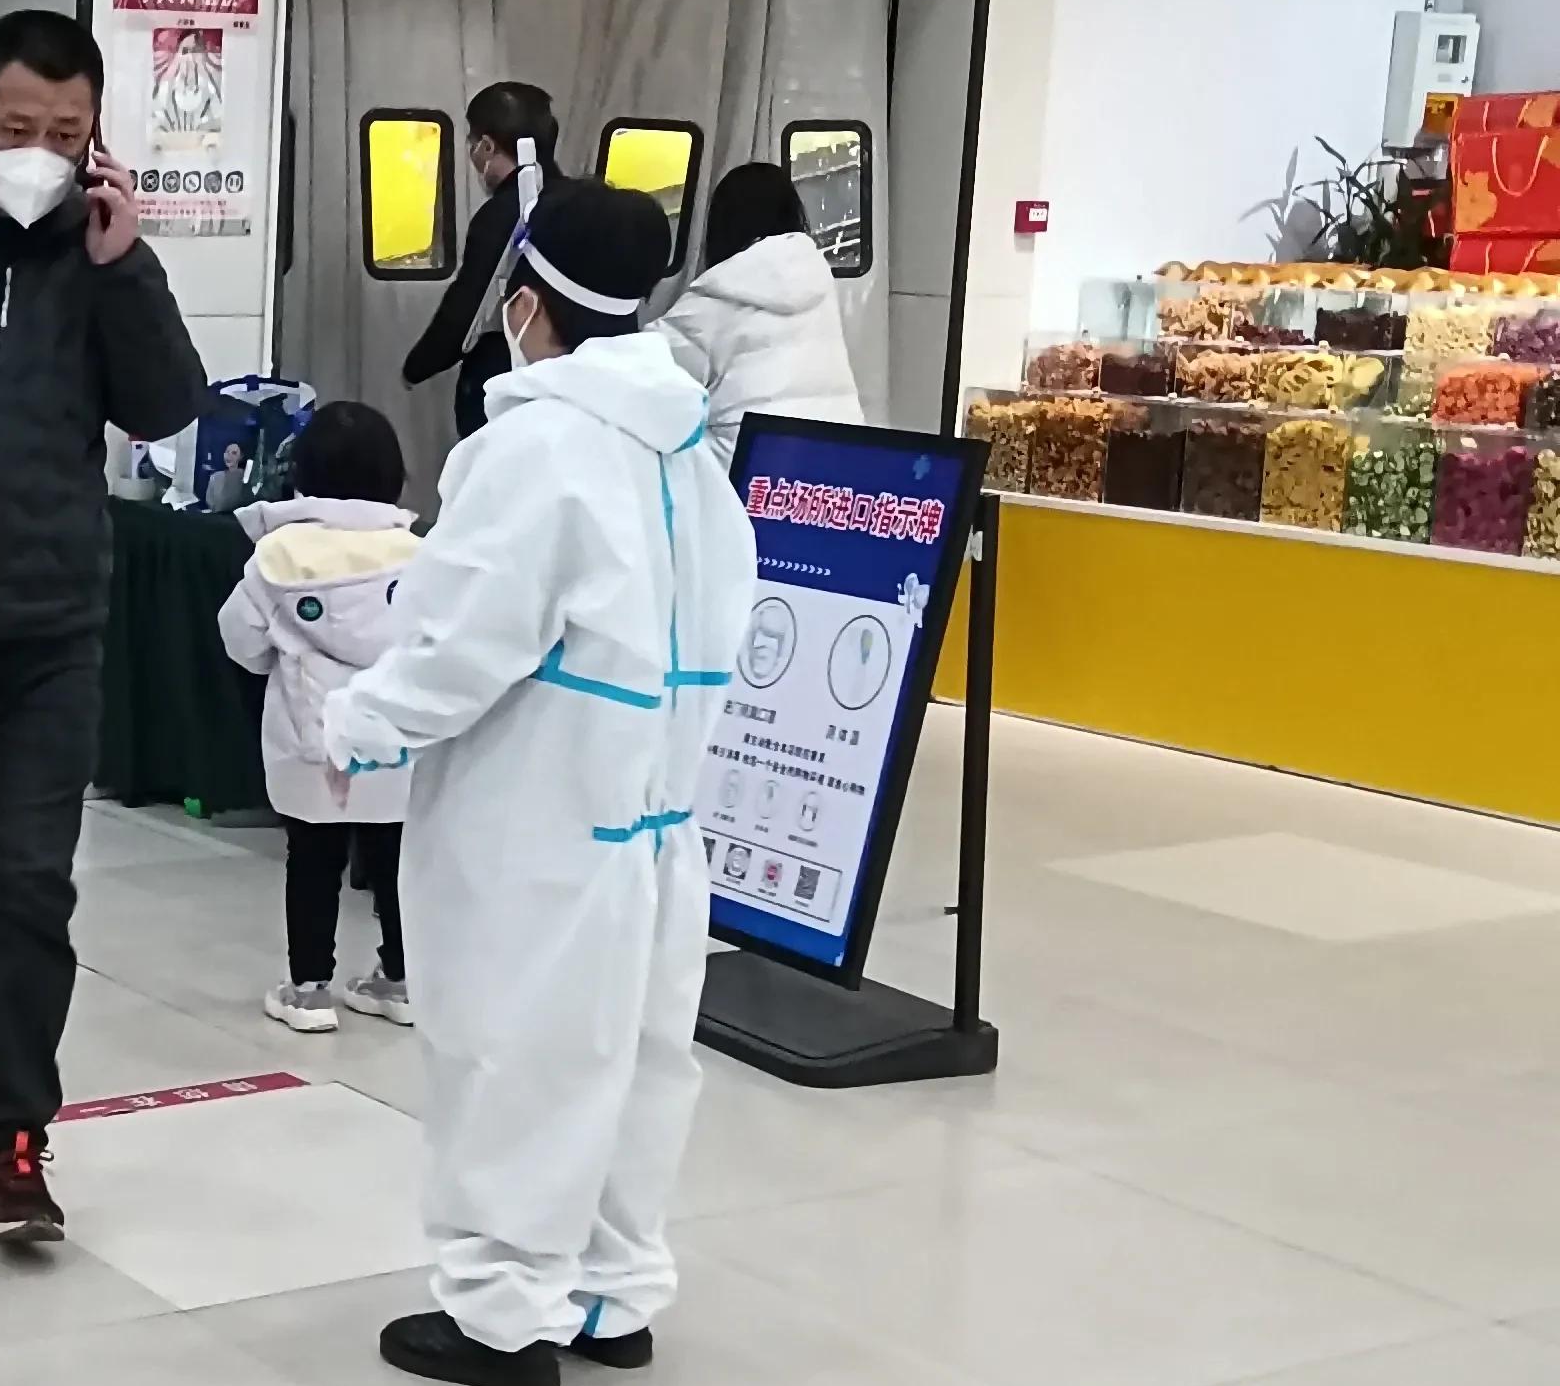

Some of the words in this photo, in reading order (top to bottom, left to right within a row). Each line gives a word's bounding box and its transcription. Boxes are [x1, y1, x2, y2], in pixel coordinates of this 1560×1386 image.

[746, 476, 946, 545] 重点场所进口指示牌
